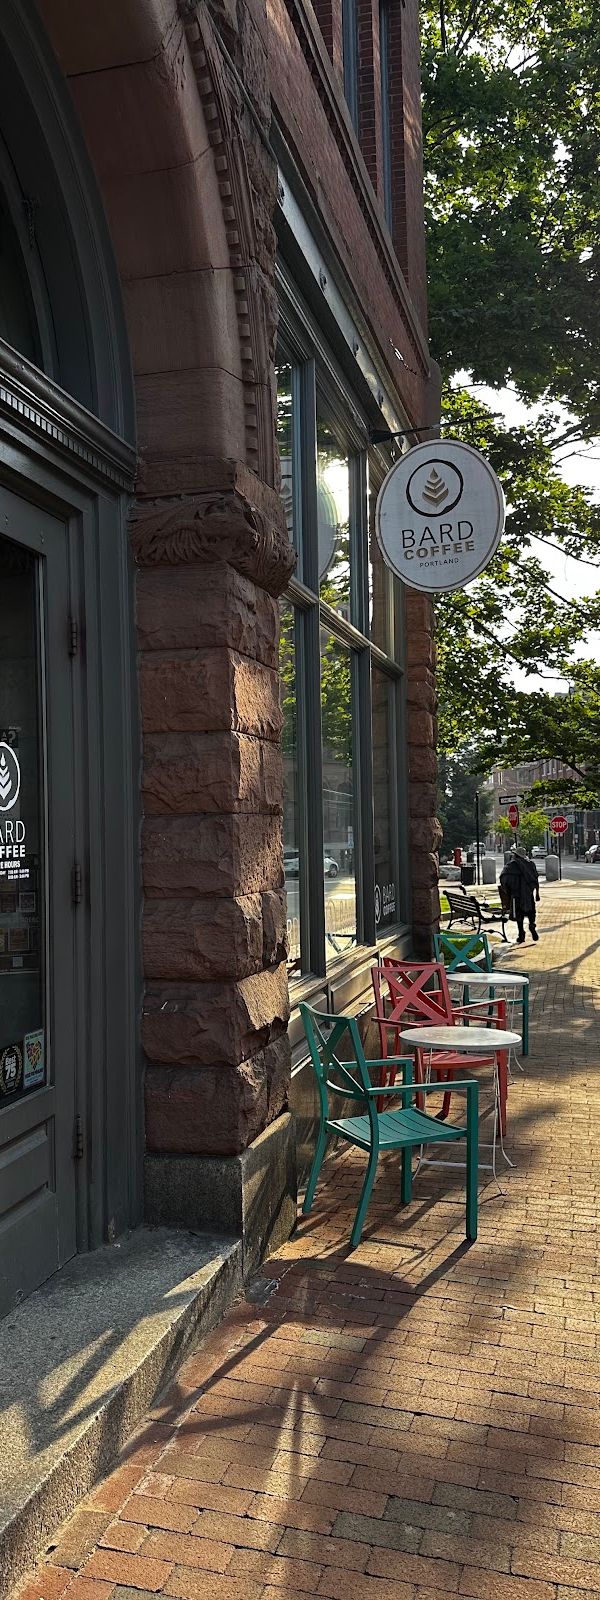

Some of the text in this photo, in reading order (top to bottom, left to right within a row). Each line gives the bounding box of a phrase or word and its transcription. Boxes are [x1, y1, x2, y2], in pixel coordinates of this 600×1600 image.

[402, 521, 473, 548] BARD
[404, 541, 475, 560] COFFEE
[420, 558, 459, 567] PORTLAND
[4, 860, 21, 869] HOURS
[383, 883, 395, 904] BARD
[5, 1063, 17, 1080] 75
